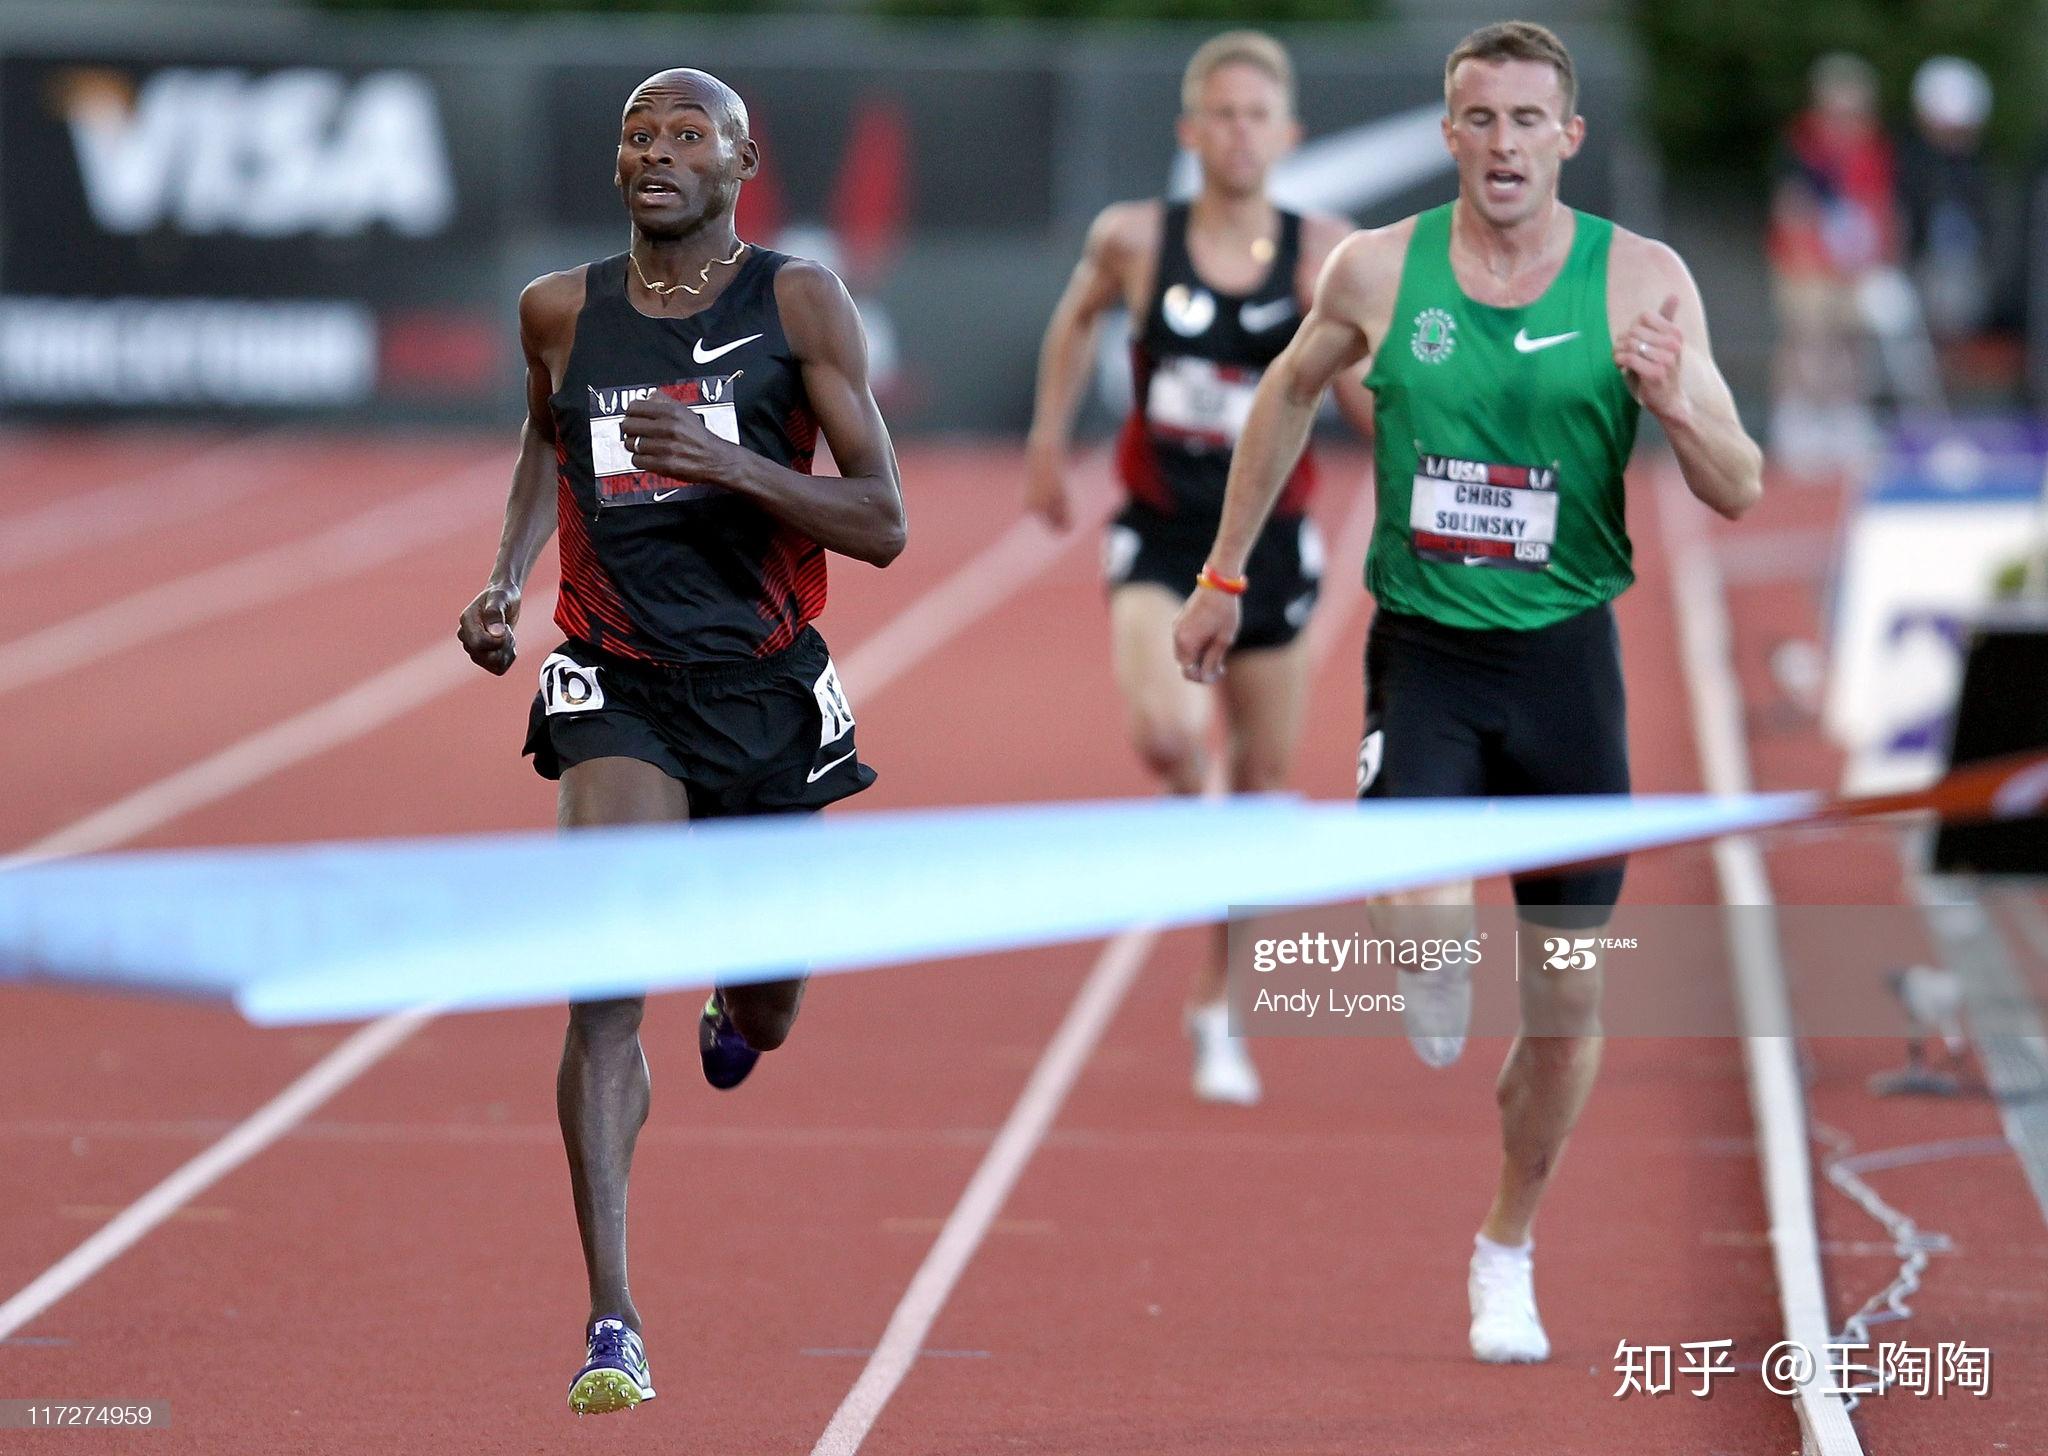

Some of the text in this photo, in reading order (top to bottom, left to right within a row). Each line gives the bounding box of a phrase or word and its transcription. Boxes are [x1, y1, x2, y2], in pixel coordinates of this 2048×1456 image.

[52, 66, 457, 238] VISA
[620, 387, 657, 411] US
[1447, 459, 1489, 484] USA
[1455, 484, 1513, 508] CHRIS
[1436, 510, 1527, 537] SOLINSKY
[1514, 542, 1549, 563] USA
